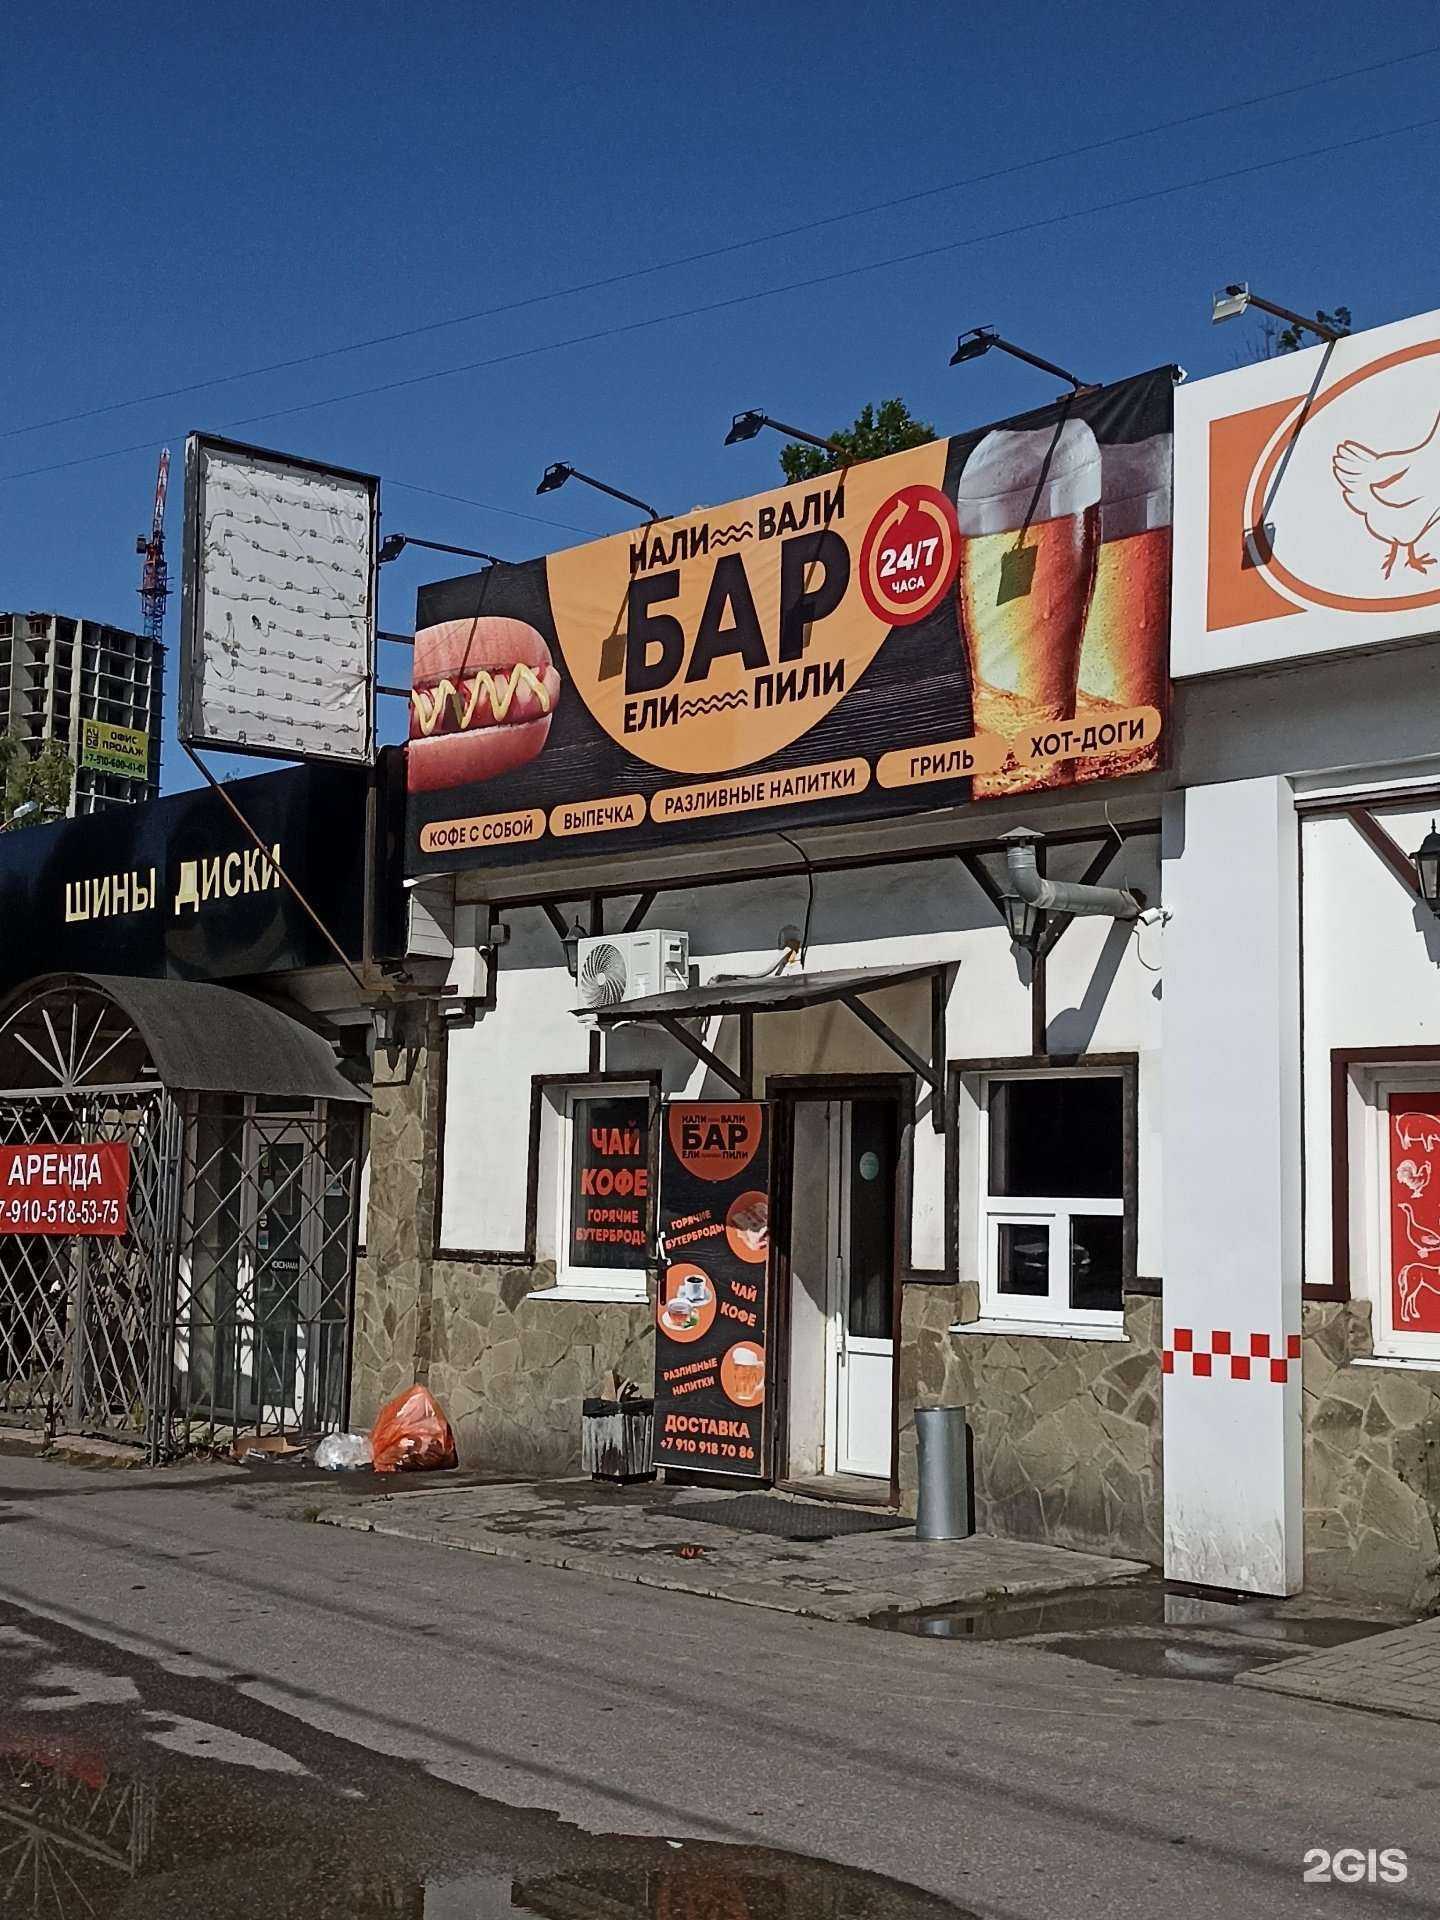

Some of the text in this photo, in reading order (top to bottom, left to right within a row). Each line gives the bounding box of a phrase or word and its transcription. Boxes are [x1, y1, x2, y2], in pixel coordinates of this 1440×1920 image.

[629, 485, 845, 574] НАЛИ ВАЛИ
[879, 537, 939, 578] 24/7
[891, 577, 925, 594] ЧАСА
[625, 529, 851, 696] БАР
[623, 658, 845, 734] ЕЛИ ПИЛИ
[102, 741, 143, 757] ПРОДАЖ
[110, 731, 139, 744] ОФИС
[1030, 718, 1145, 758] ХОТ-ДОГИ
[910, 749, 974, 778] ГРИЛЬ
[665, 767, 856, 816] РАЗЛИВНЫЕ НАПИТКИ
[564, 804, 634, 830] ВЫПЕЧКА
[428, 814, 534, 848] КОФЕ С СОБОЙ
[65, 843, 281, 923] ШИНЫ ДИСКИ
[720, 1114, 746, 1123] ВАЛИ
[592, 1120, 640, 1156] ЧАЙ
[682, 1123, 749, 1151] БАР
[682, 1151, 748, 1160] ЕЛИ ПИЛИ
[7, 1153, 102, 1192] АРЕНДА
[580, 1168, 648, 1196] КОФЕ
[587, 1208, 639, 1223] ГОРЯЧИЕ
[671, 1209, 712, 1231] ГОРЯЧИЕ
[665, 1223, 725, 1250] БУТЕРБРОДЫ
[730, 1280, 758, 1303] ЧАЙ
[720, 1302, 758, 1328] КОФЕ
[663, 1357, 719, 1381] РАЗЛИВНЫЕ
[672, 1375, 715, 1396] НАПИТКИ
[664, 1414, 750, 1439] ДОСТАВКА
[660, 1437, 755, 1460] +7 910 918 70 86
